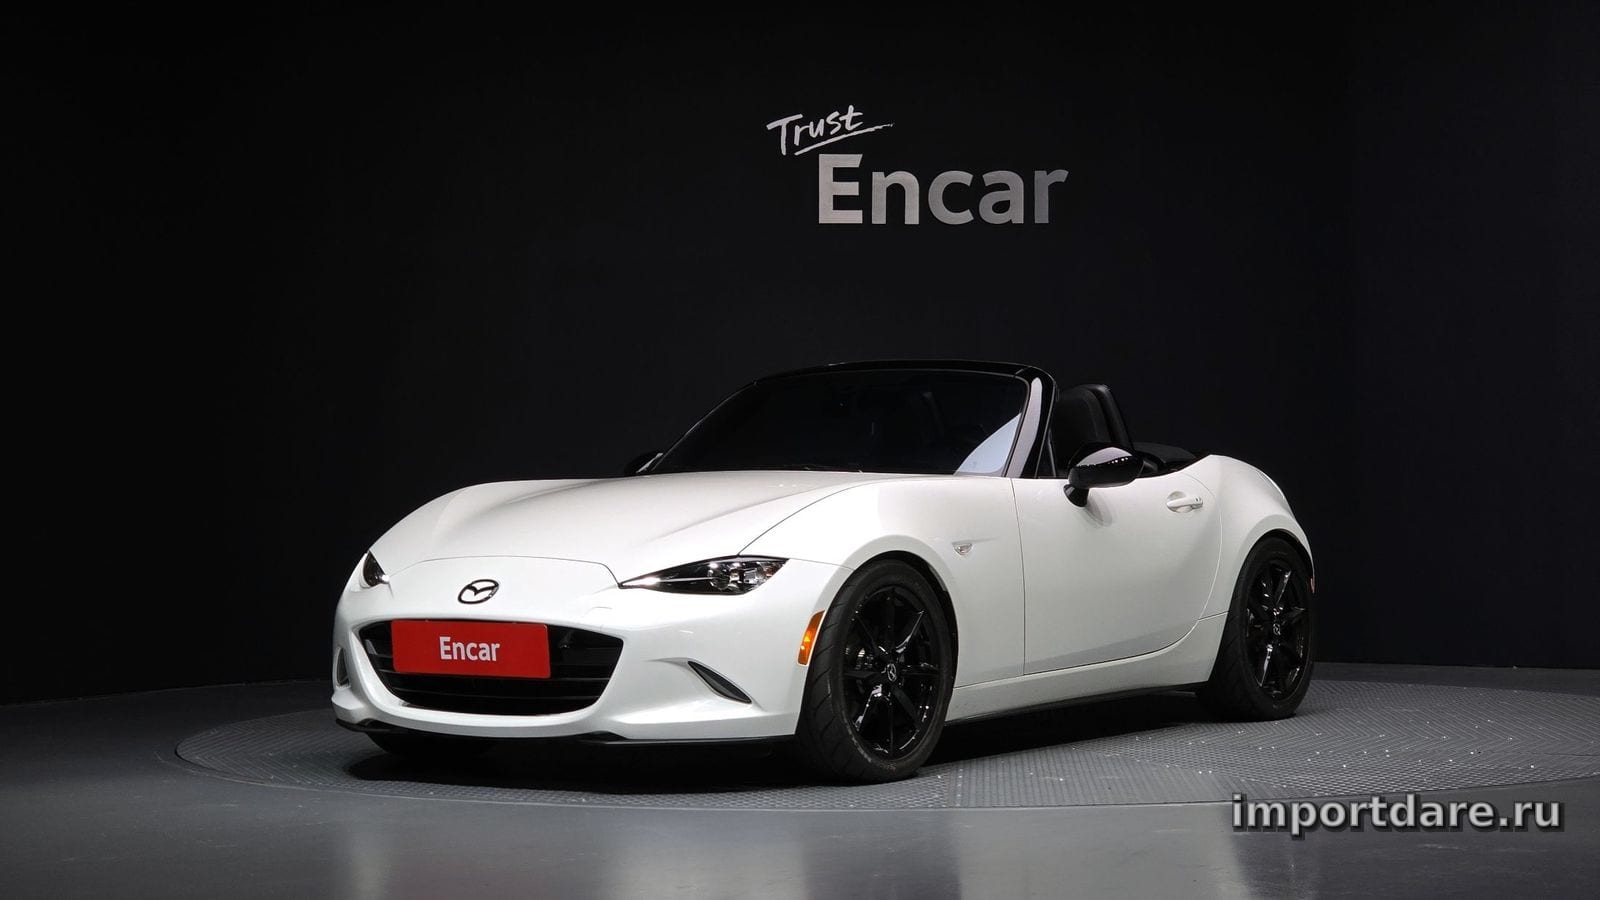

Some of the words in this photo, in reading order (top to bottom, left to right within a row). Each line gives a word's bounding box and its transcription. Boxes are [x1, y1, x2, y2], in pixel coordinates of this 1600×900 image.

[766, 104, 864, 156] Trust
[818, 153, 1069, 225] Encar
[439, 636, 500, 661] Encar
